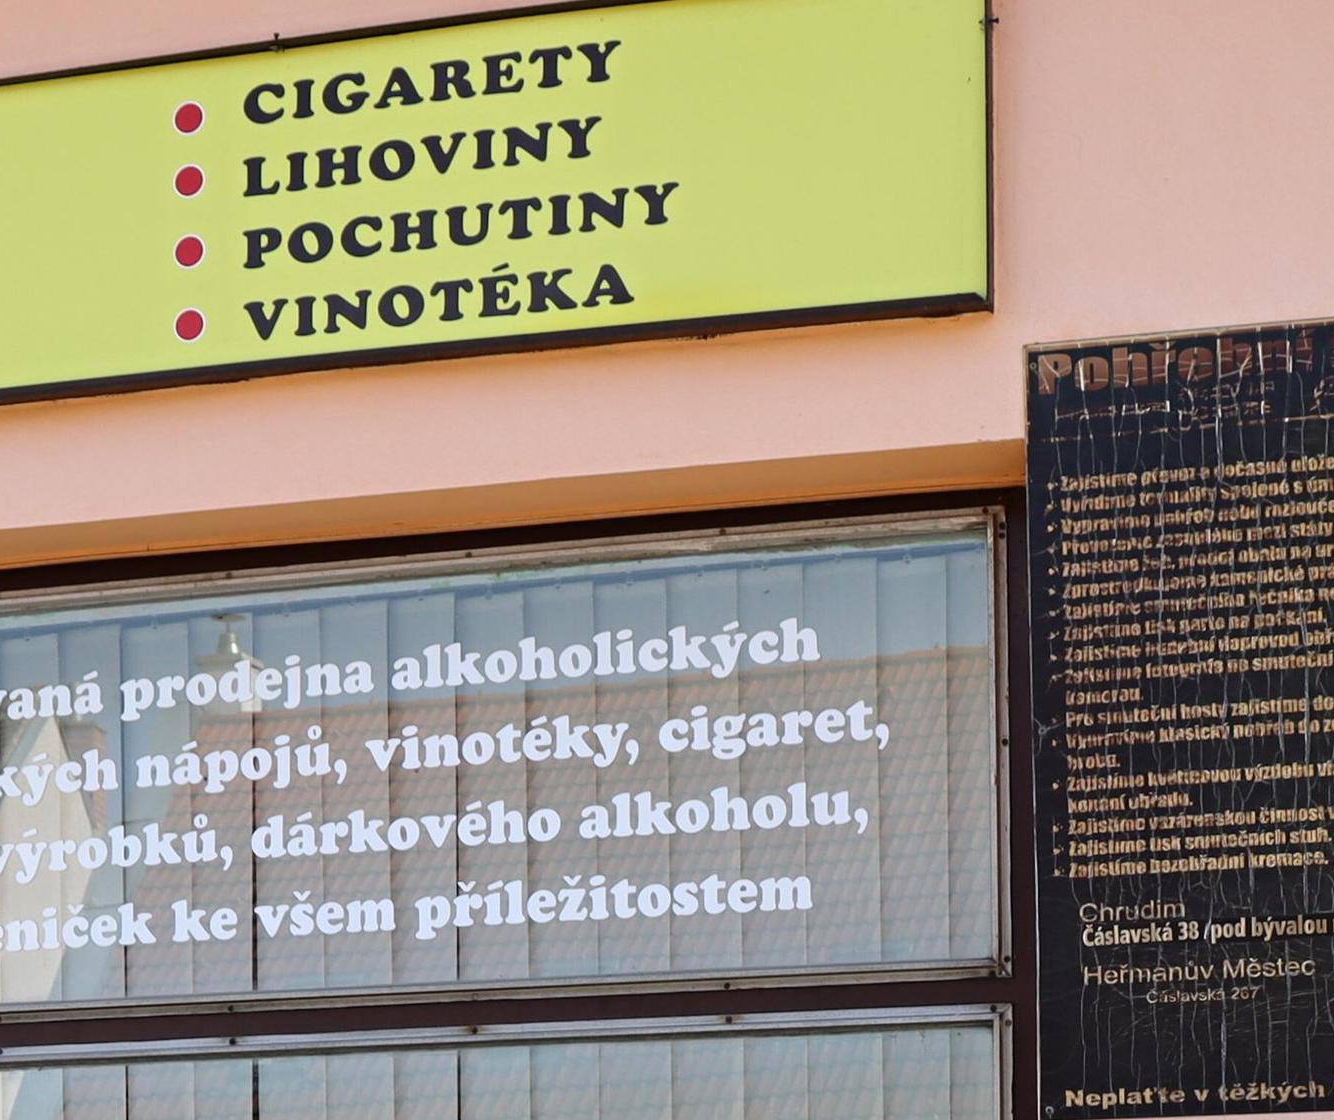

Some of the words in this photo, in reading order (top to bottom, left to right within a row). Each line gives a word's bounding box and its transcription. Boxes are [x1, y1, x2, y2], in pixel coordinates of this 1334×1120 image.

[243, 40, 622, 124] CIGARETY
[243, 116, 603, 197] LIHOVINY
[243, 181, 679, 269] POCHUTINY
[243, 264, 634, 340] VINOTÉKA
[120, 654, 374, 721] prodejna
[391, 617, 821, 691] alkoholických
[136, 725, 348, 793] nápojů,
[366, 715, 640, 773] vinotéky,
[658, 699, 890, 761] cigaret,
[251, 801, 561, 858] dárkového
[579, 781, 869, 840] alkoholu,
[172, 899, 238, 944] ke
[255, 891, 396, 938] všem
[414, 873, 813, 940] příležitostem
[1079, 900, 1185, 923] Chrudim
[1082, 922, 1173, 947] Čáslavská
[1178, 921, 1199, 940] 38
[1251, 914, 1327, 941] bývalou
[1083, 960, 1214, 985] Heřmanův
[1222, 957, 1316, 979] Městec
[1146, 988, 1225, 1004] Čáslavská
[1231, 985, 1259, 1000] 267
[1194, 1088, 1210, 1102] v
